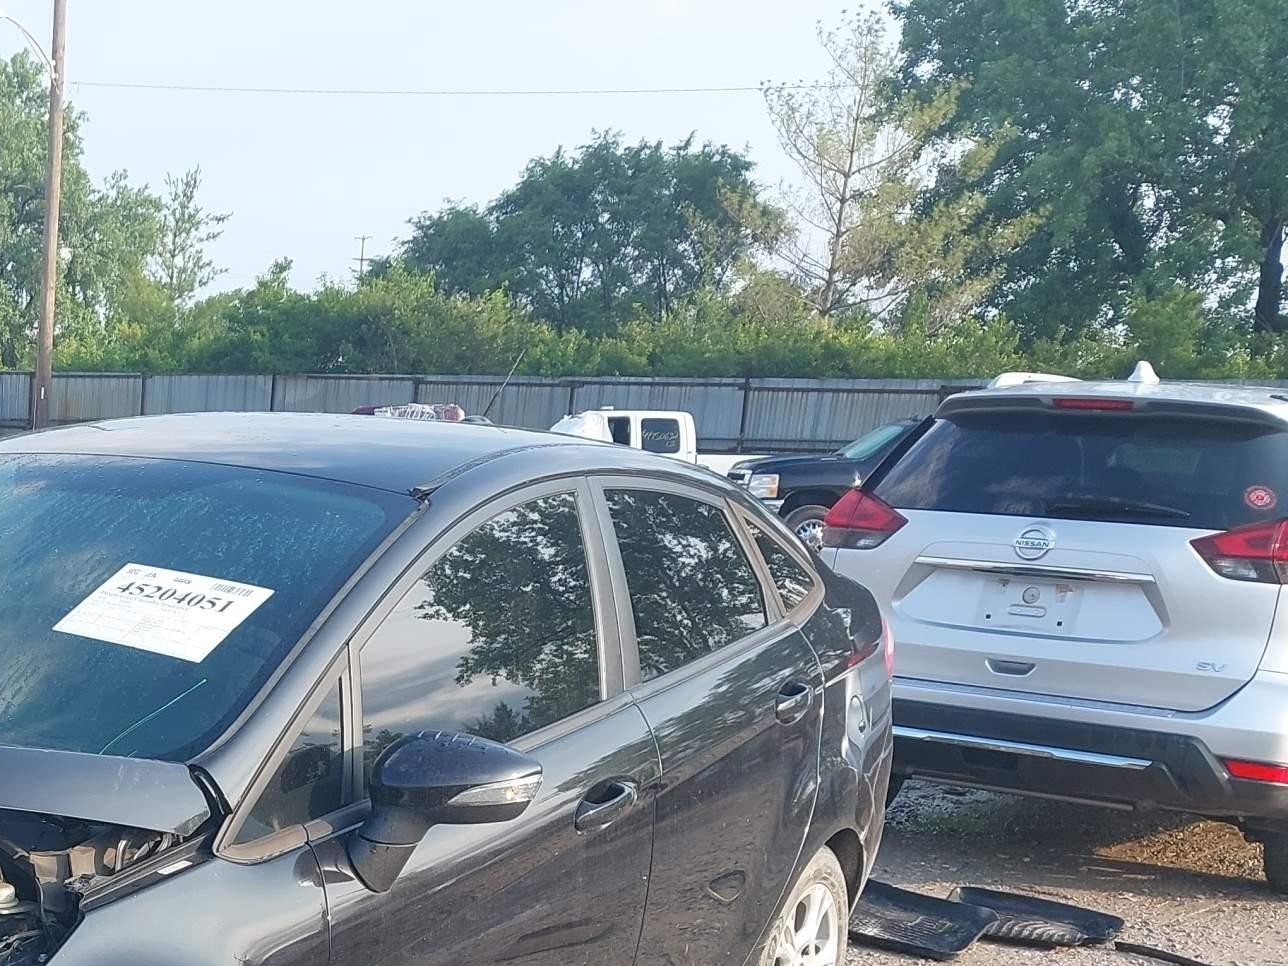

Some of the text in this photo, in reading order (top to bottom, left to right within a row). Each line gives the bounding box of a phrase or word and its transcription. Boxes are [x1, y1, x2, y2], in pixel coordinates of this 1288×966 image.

[1015, 539, 1050, 548] NISSAN
[117, 581, 235, 613] 45204051
[1195, 661, 1225, 673] SV
